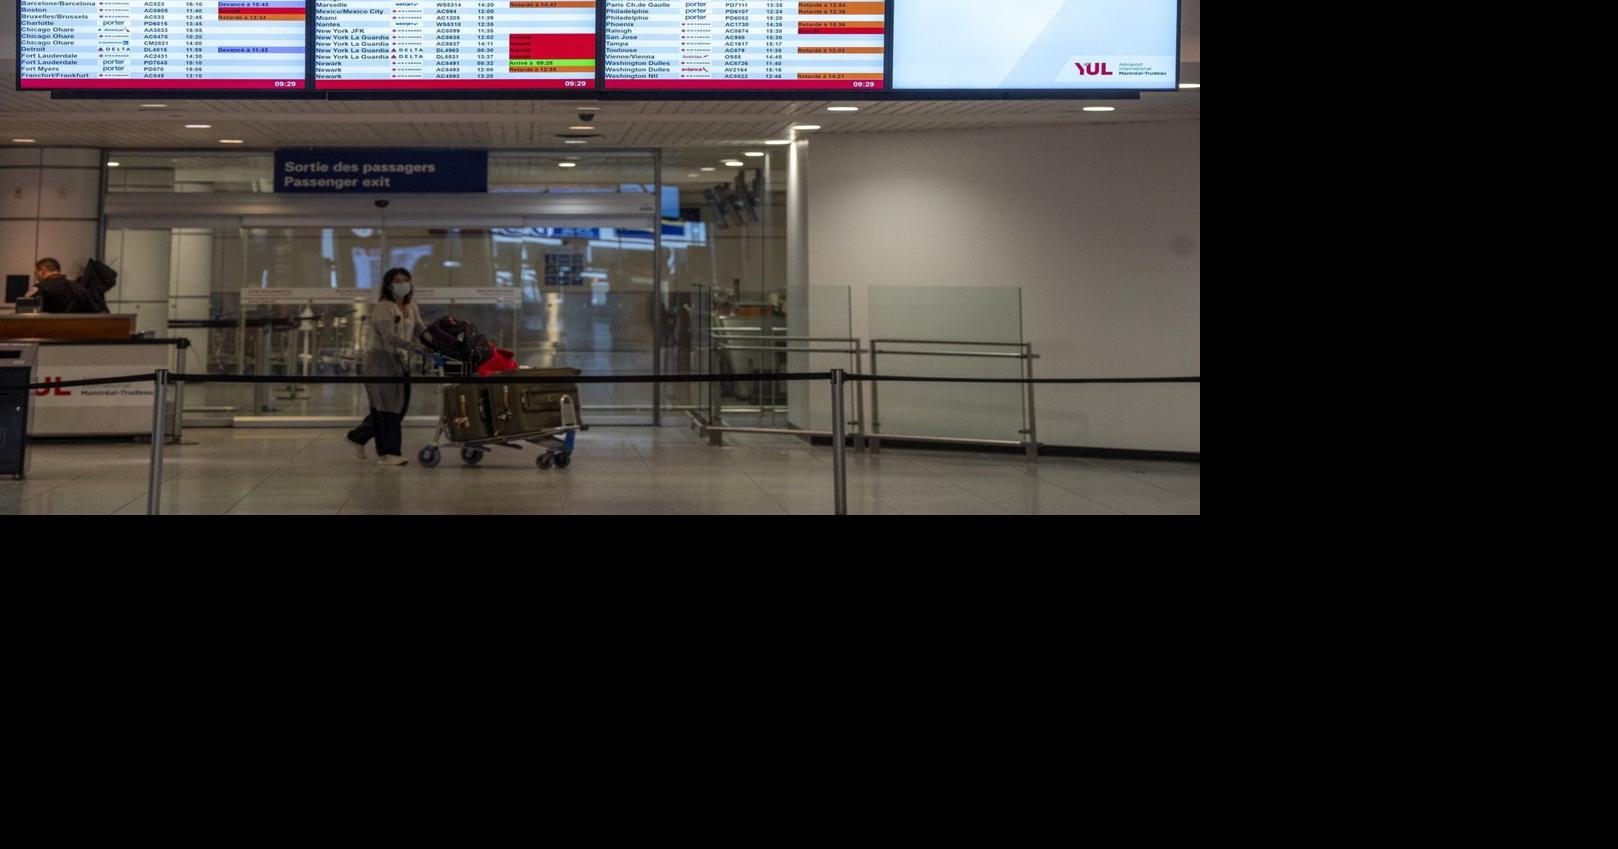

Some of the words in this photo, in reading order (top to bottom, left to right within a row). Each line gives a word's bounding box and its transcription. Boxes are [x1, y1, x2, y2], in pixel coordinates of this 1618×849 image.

[1075, 62, 1113, 75] YUL
[284, 162, 329, 173] Sortie
[333, 162, 358, 173] des
[363, 163, 435, 174] passagers
[284, 176, 358, 189] Passenger
[362, 176, 390, 187] exit
[32, 376, 71, 396] UL
